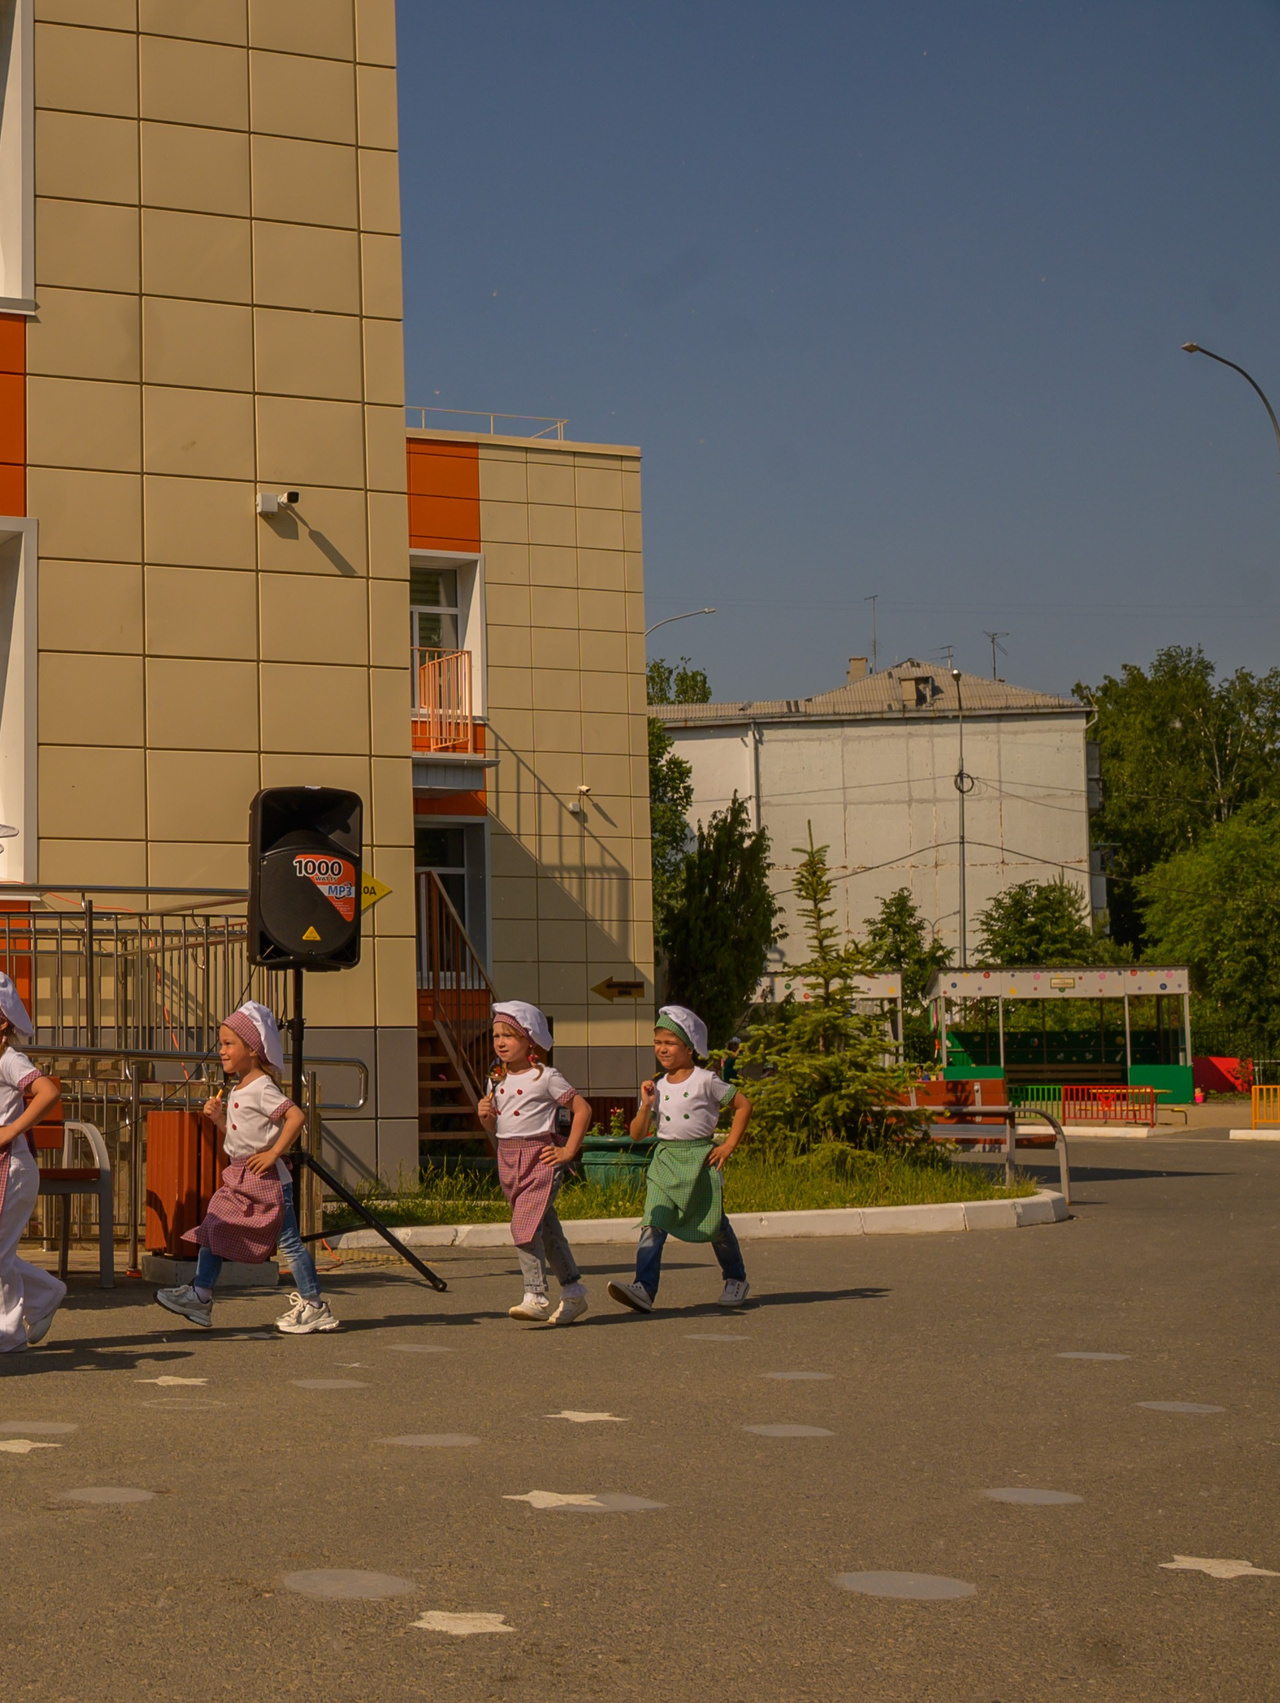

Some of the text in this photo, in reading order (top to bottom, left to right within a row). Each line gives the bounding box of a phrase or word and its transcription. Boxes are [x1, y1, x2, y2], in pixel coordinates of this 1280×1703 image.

[293, 859, 342, 876] 1000
[328, 885, 352, 896] MP3
[362, 886, 377, 895] ОД
